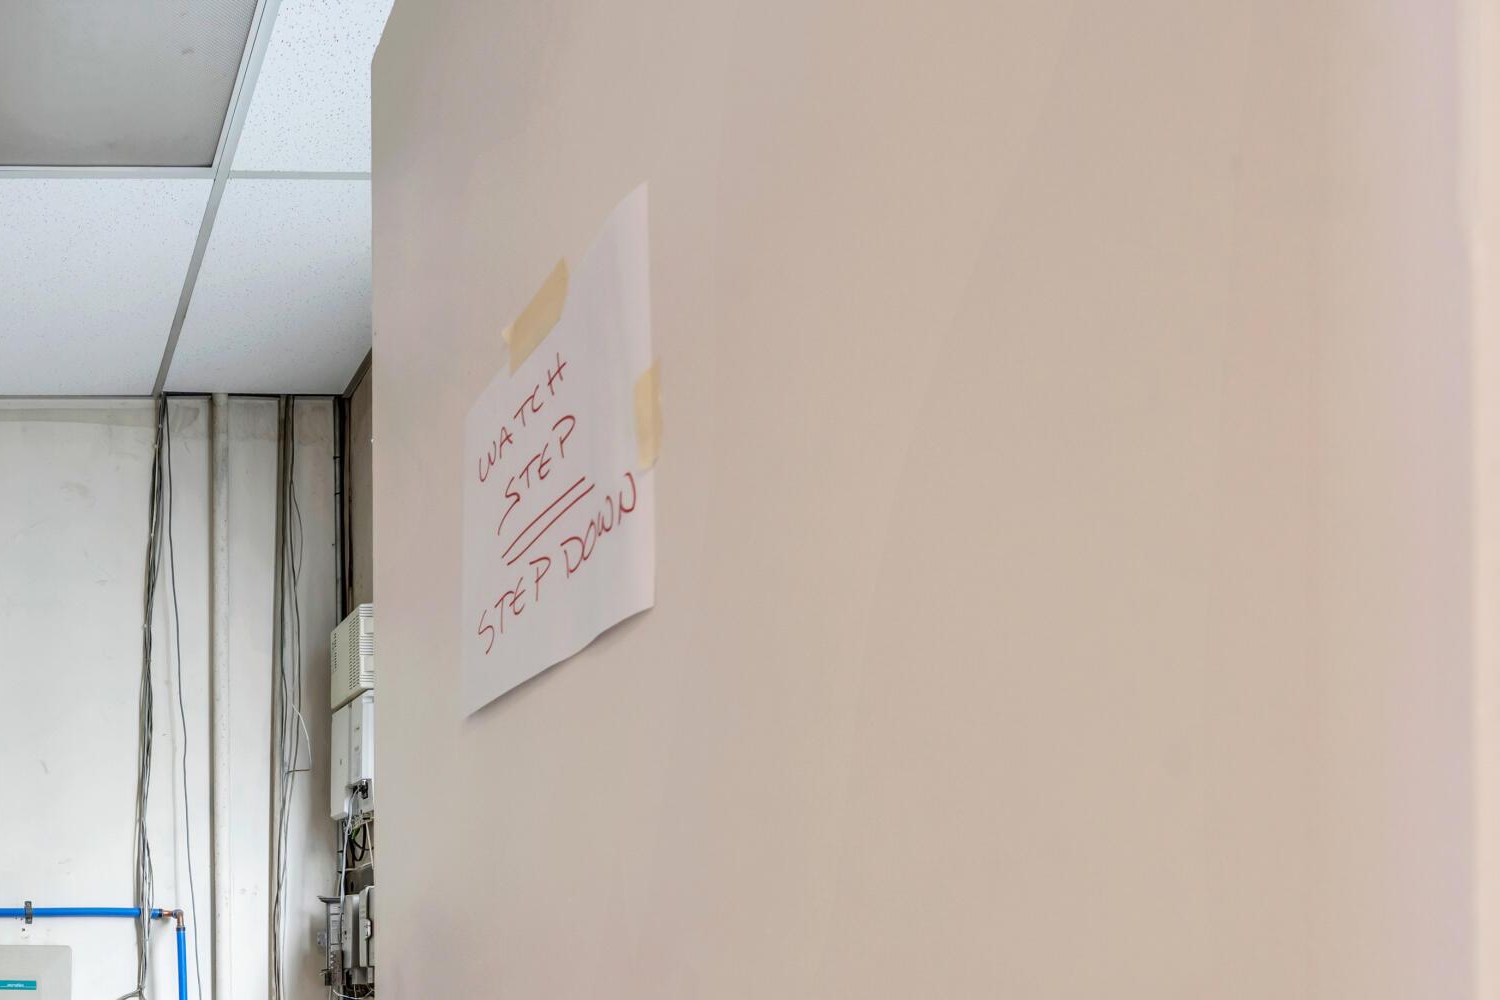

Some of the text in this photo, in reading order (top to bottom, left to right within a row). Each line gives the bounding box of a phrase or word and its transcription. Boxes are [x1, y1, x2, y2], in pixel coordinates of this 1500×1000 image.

[479, 352, 567, 482] WATCH
[497, 415, 575, 536] STEP
[478, 472, 636, 655] STEP DOWN
